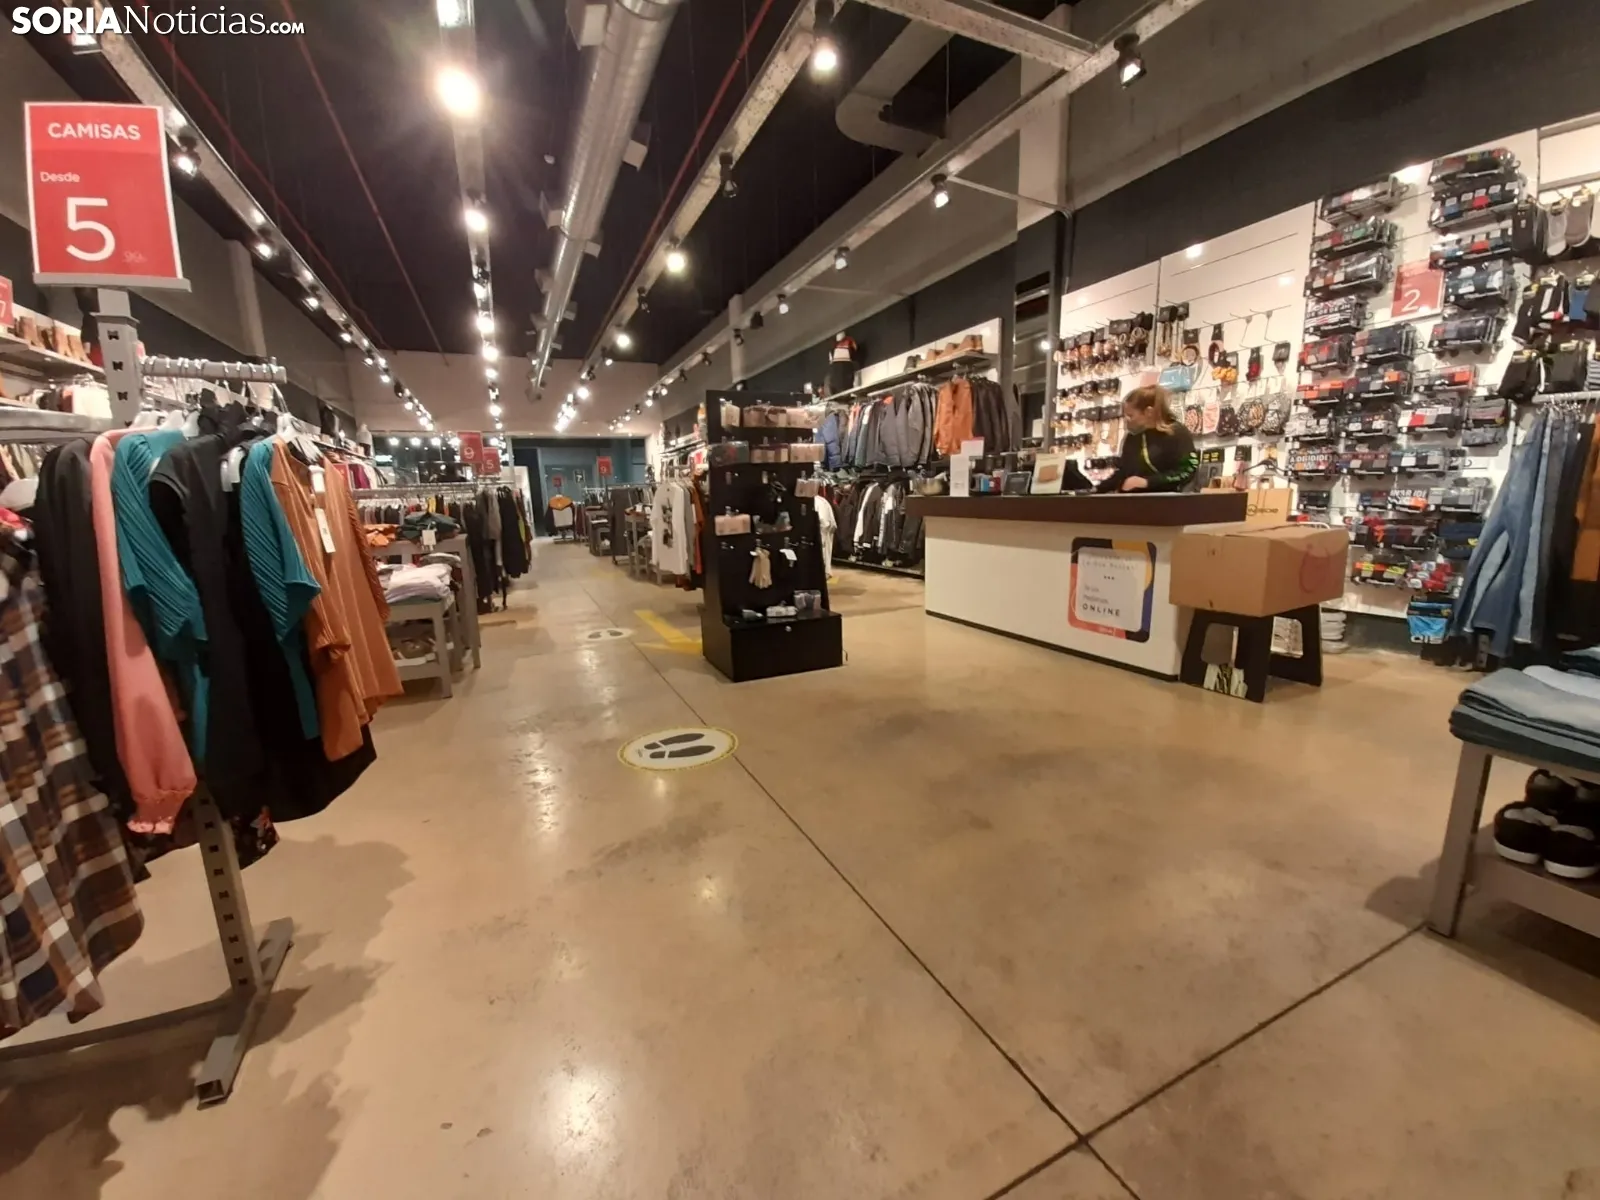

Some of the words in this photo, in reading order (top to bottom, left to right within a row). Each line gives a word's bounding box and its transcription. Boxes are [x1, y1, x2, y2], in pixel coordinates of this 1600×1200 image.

[48, 123, 141, 140] CAMISAS
[39, 171, 81, 183] Desde
[66, 197, 116, 262] 5
[1401, 289, 1420, 312] 2
[464, 447, 475, 459] 9
[1082, 603, 1120, 617] ONLINE
